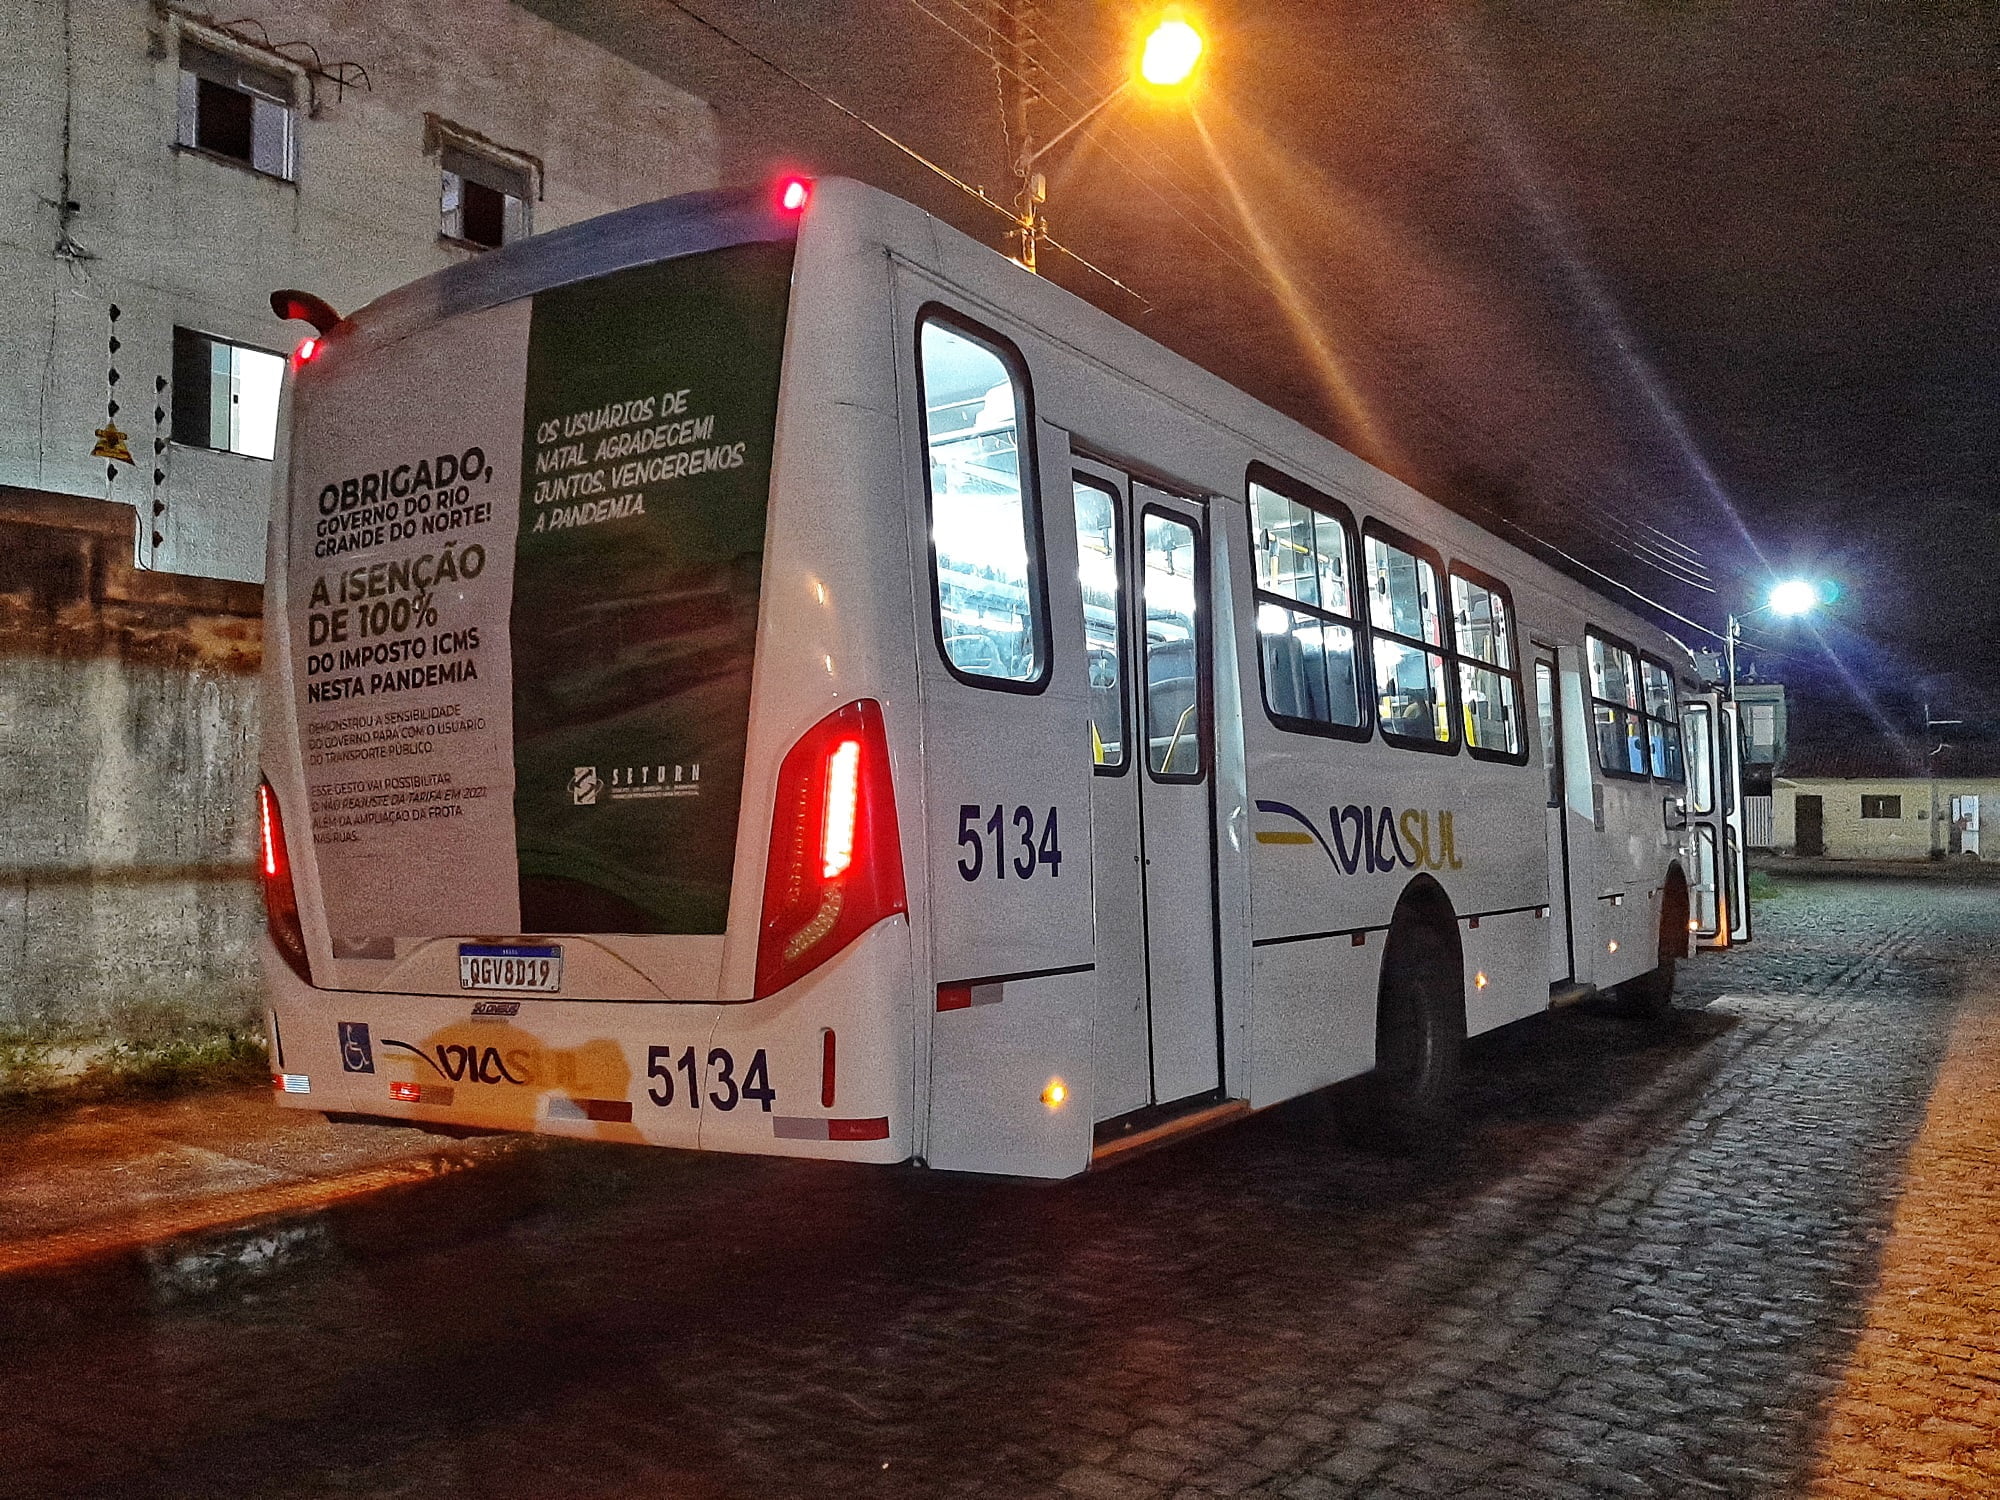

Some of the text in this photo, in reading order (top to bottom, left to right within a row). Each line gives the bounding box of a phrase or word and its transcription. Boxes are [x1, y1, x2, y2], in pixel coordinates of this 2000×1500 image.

[537, 419, 560, 444] OS
[661, 389, 691, 417] DE
[318, 446, 493, 515] OBRIGADO,
[536, 443, 588, 474] NATAL
[612, 442, 746, 489] VENCEREMOS
[315, 502, 492, 558] GRANDE DO NORTE!
[317, 486, 470, 538] GOVERNO DO RIO
[532, 512, 544, 533] A
[309, 540, 486, 609] A ISENÇÃO
[309, 593, 438, 647] DE 100%
[308, 627, 480, 676] DO IMPOSTO ICMS
[308, 658, 478, 703] NESTA PANDEMIA
[384, 704, 461, 724] SENSIBILIDADE
[612, 764, 700, 786] SETURN
[958, 804, 1062, 882] 5134
[470, 958, 550, 987] QGV8D19
[647, 1045, 776, 1112] 5134
